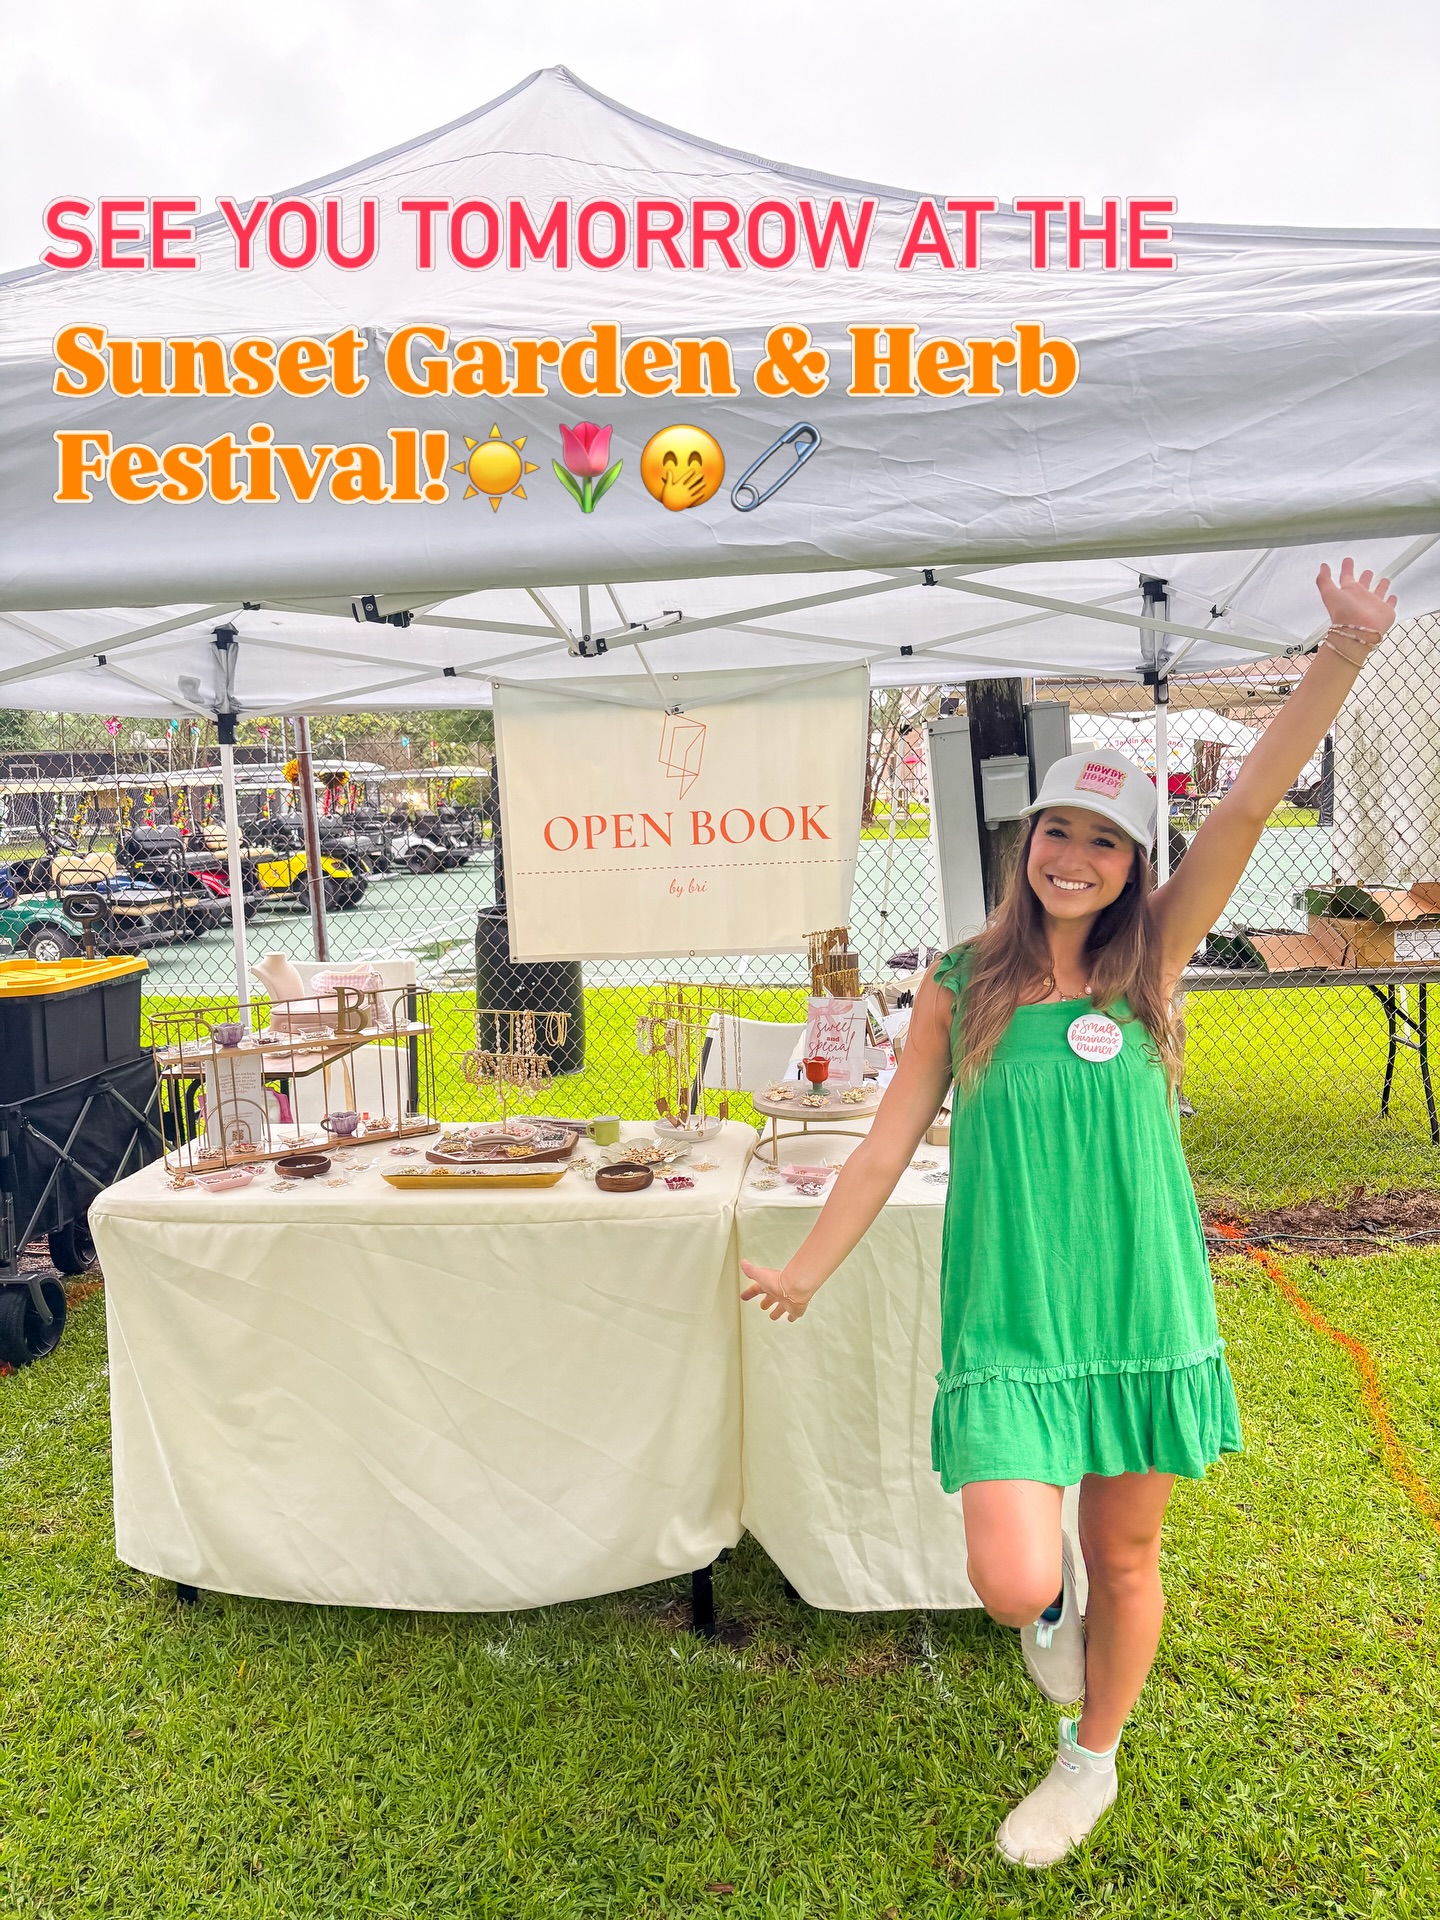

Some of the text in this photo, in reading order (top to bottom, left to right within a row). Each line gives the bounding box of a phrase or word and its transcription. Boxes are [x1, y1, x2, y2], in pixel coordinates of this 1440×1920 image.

[1082, 772, 1120, 788] HOWDY
[1086, 763, 1123, 779] HOWDY
[543, 804, 832, 851] OPEN BOOK
[669, 877, 707, 898] by bri
[817, 1013, 866, 1044] sweet
[1071, 1030, 1119, 1044] business
[809, 1031, 855, 1060] special
[1076, 1042, 1118, 1055] owner
